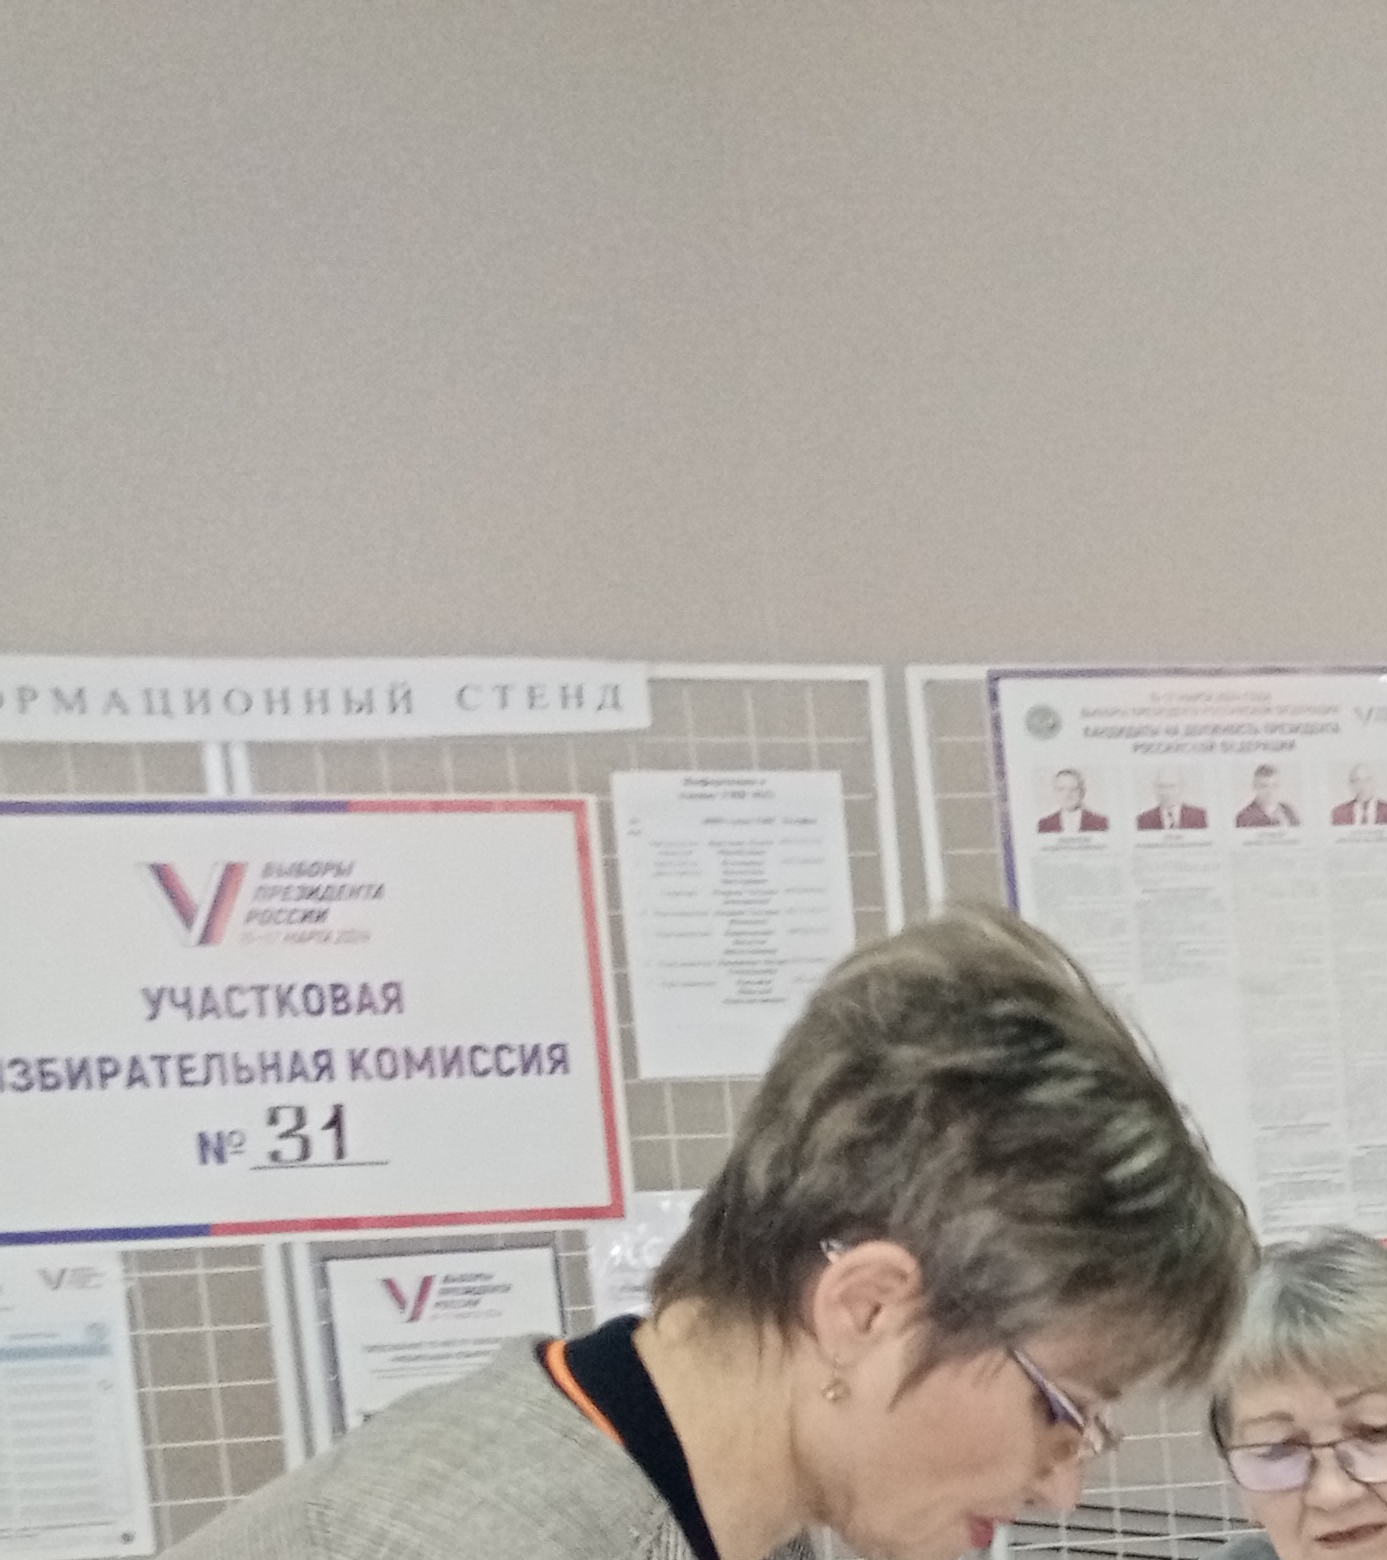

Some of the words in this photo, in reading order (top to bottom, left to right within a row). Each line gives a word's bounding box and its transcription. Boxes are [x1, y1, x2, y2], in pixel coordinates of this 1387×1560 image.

[0, 679, 413, 717] РМАЦИОННЫЙ
[455, 682, 623, 712] СТЕНД
[243, 907, 330, 925] РОССИИ
[141, 981, 405, 1021] УЧАСТКОВАЯ
[0, 1048, 335, 1092] ЗБИРАТЕЛЬНАЯ
[349, 1042, 571, 1082] КОМИССИЯ
[265, 1103, 347, 1164] 31
